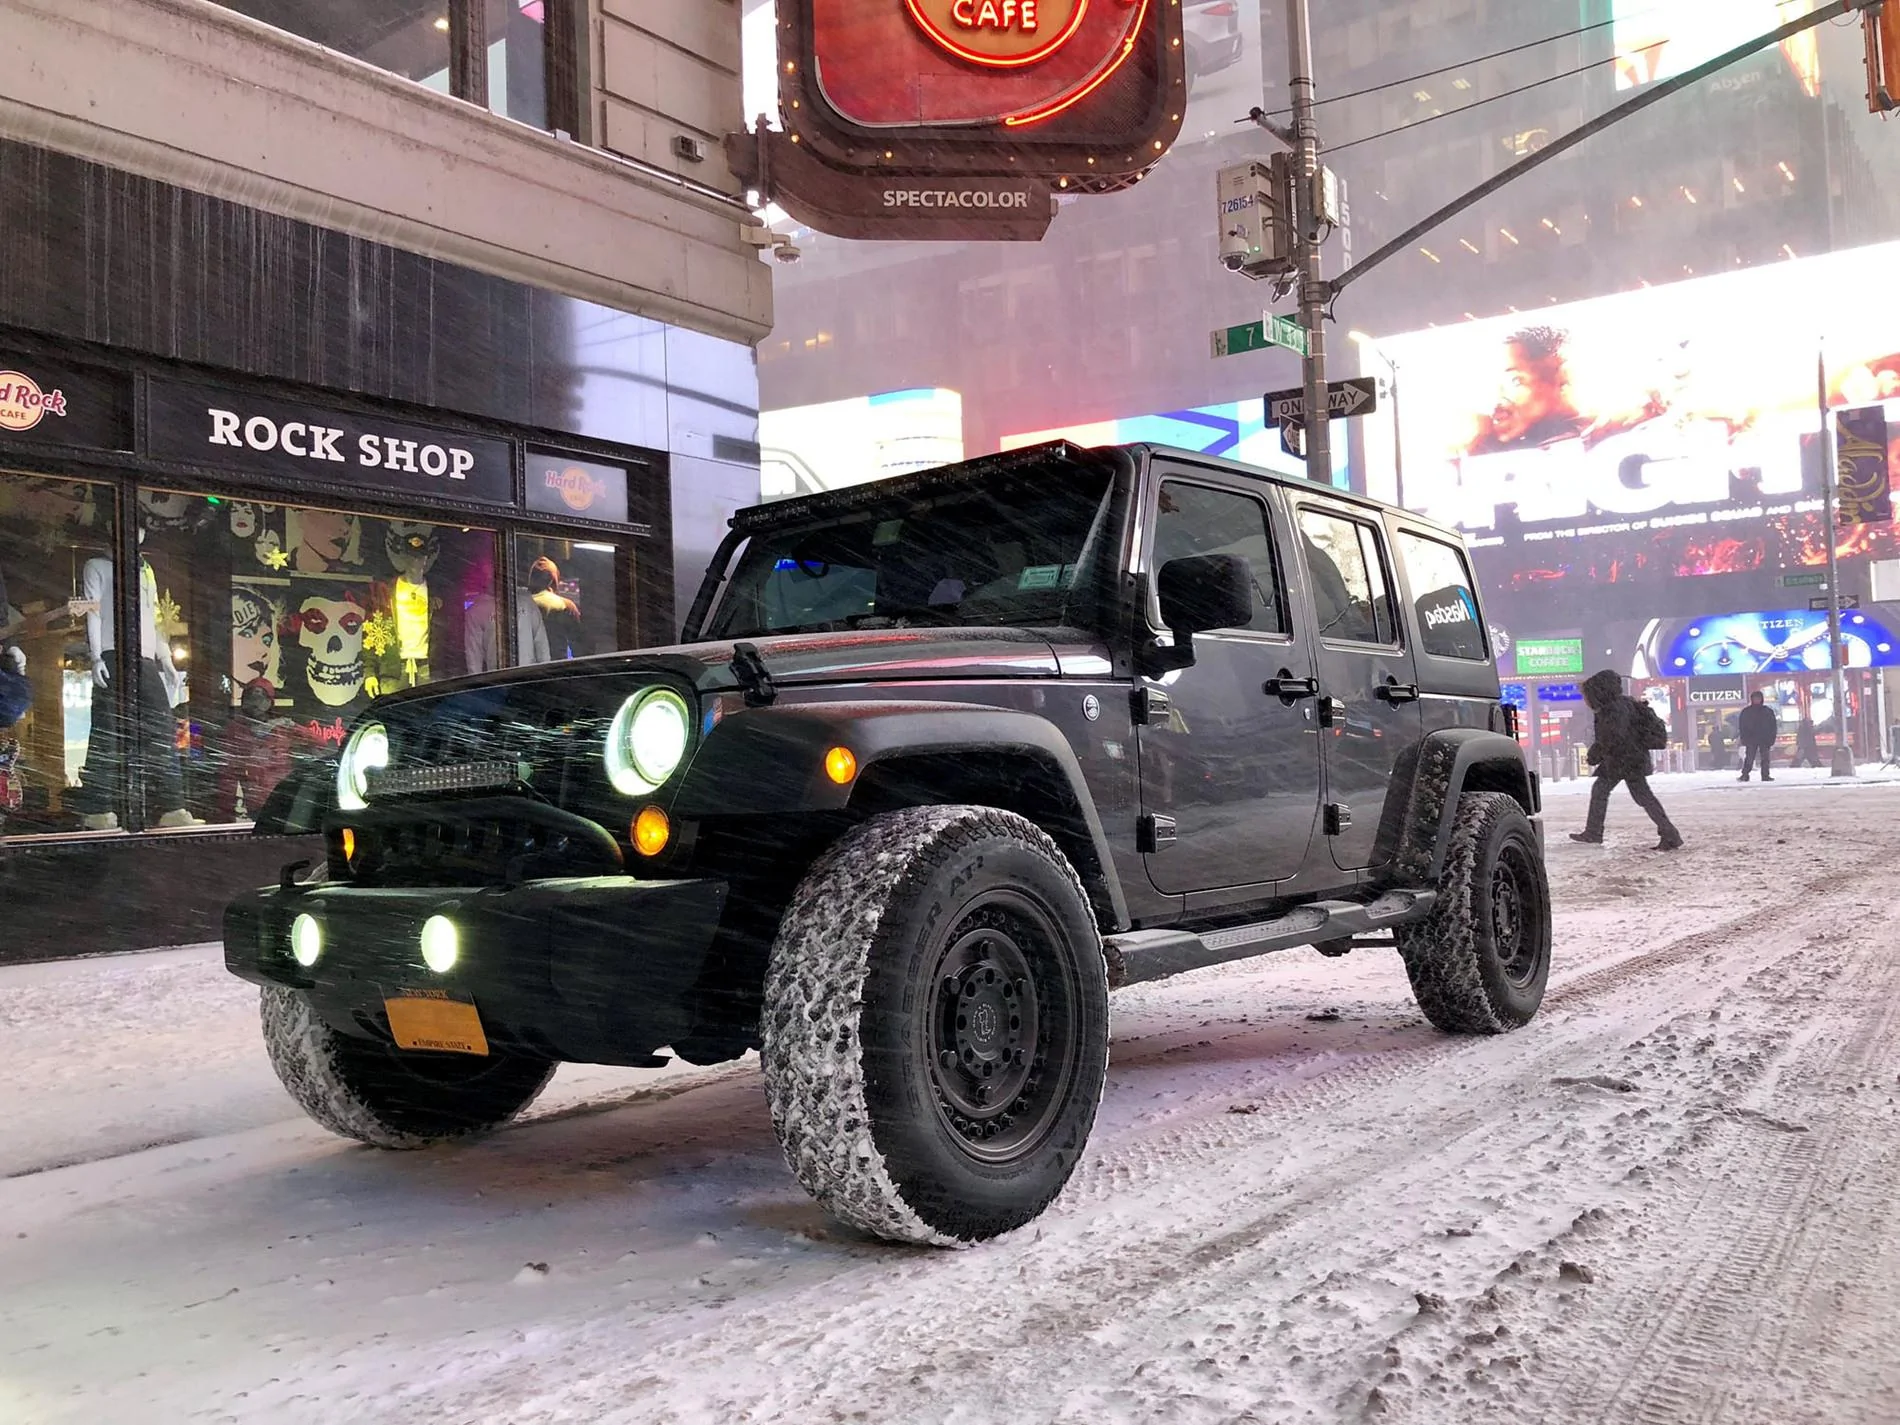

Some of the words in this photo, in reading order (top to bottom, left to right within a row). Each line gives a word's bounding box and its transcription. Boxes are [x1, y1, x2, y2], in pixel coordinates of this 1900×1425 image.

[952, 0, 1037, 29] CAFE
[883, 190, 1028, 208] SPECTACOLOR
[1246, 326, 1255, 347] 7
[15, 385, 64, 414] Rock
[1280, 400, 1305, 415] ON
[0, 409, 27, 420] CAFE
[208, 408, 345, 462] ROCK
[358, 433, 474, 480] SHOP
[545, 470, 577, 490] Hard
[1555, 528, 1576, 538] THE
[1632, 521, 1648, 530] OF
[233, 600, 257, 625] DIE
[1690, 690, 1742, 702] CITIZEN
